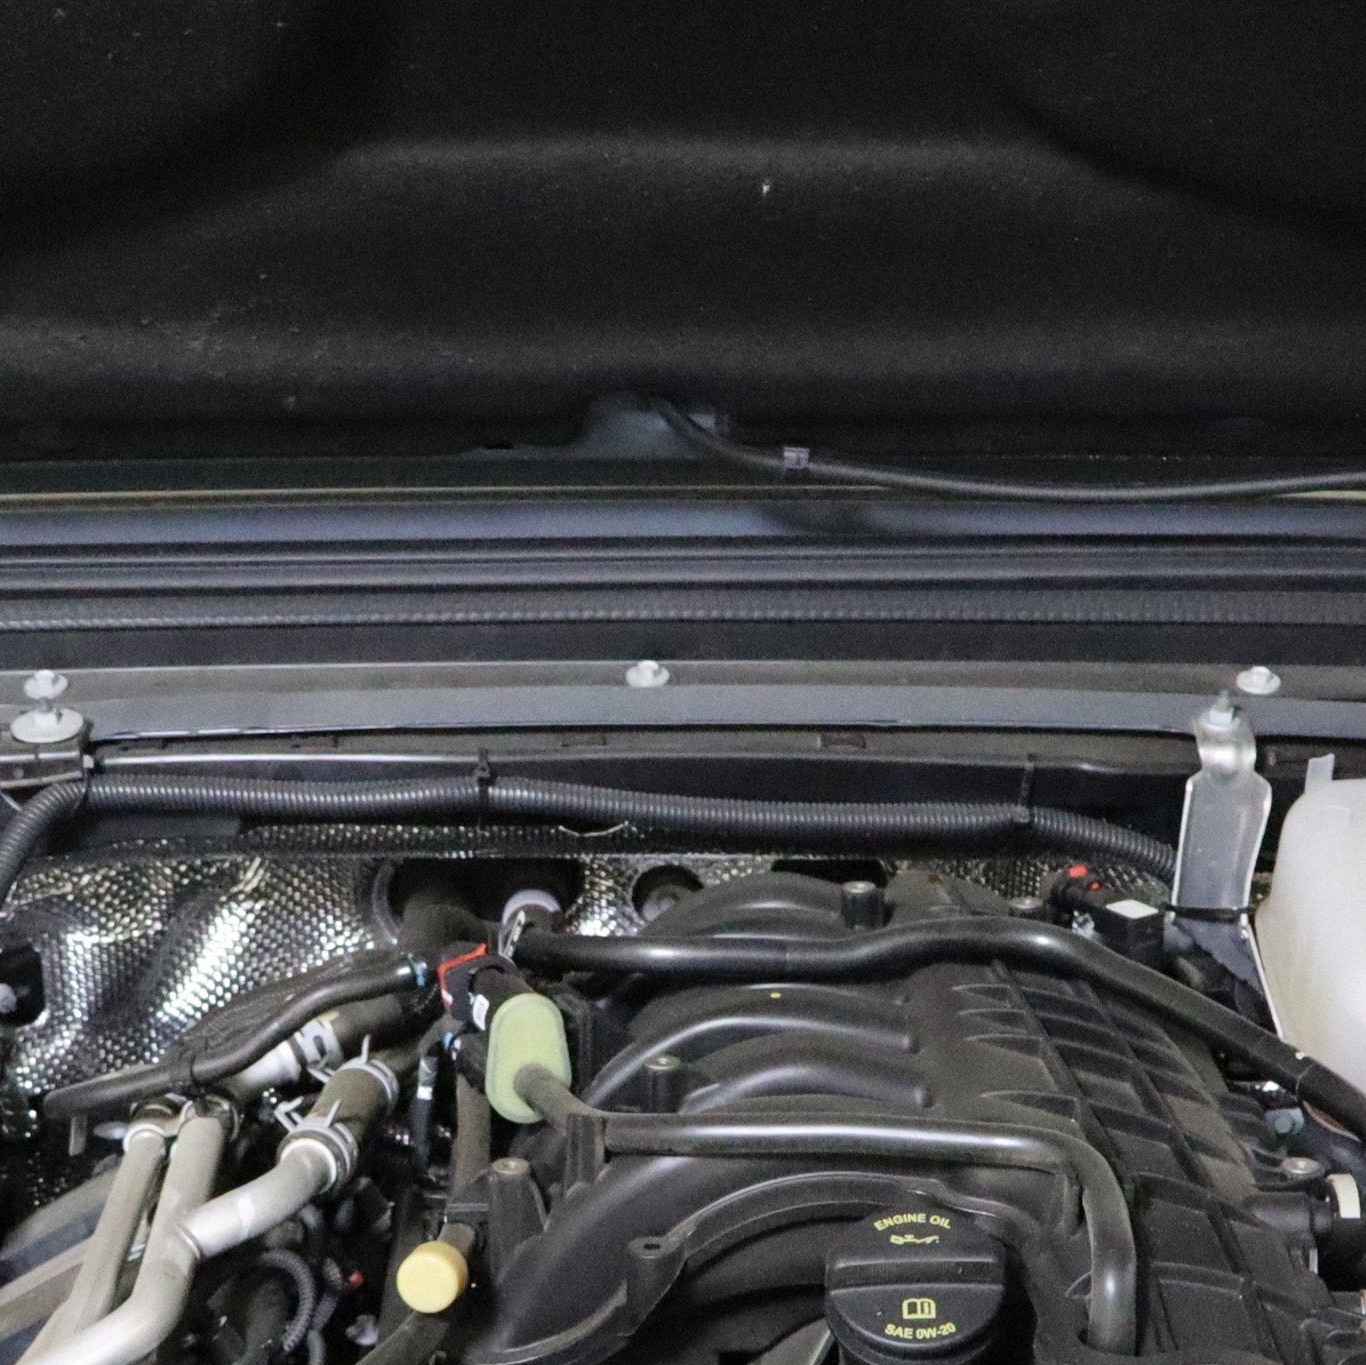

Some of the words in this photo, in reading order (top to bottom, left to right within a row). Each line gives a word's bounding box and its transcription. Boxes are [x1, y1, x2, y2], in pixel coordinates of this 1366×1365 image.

[873, 1213, 927, 1231] ENGINE
[929, 1214, 951, 1229] OIL
[884, 1323, 914, 1339] SAE
[915, 1321, 956, 1340] 0W-20
